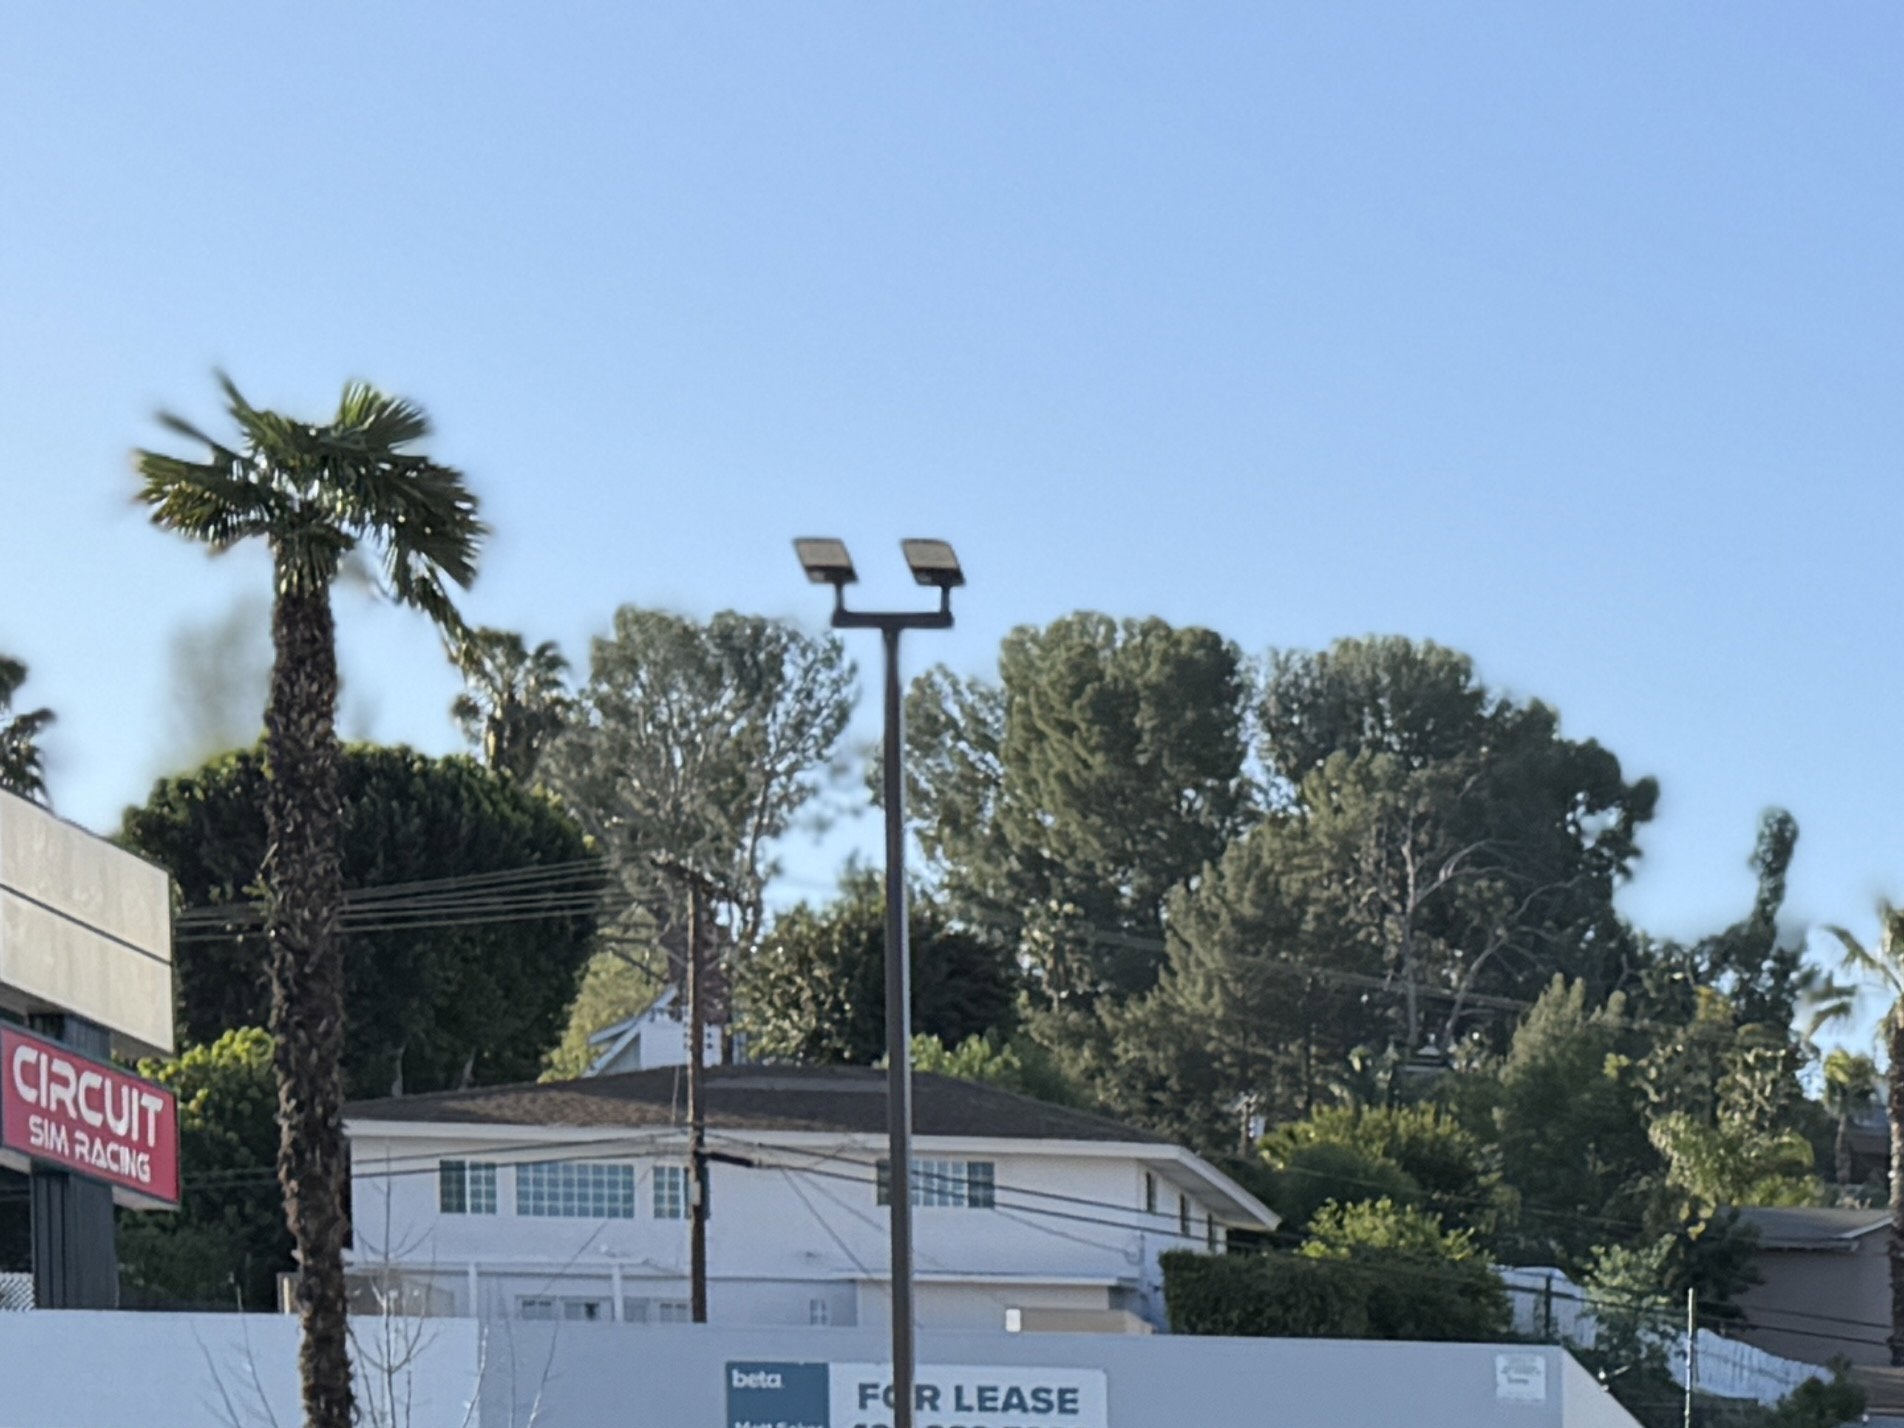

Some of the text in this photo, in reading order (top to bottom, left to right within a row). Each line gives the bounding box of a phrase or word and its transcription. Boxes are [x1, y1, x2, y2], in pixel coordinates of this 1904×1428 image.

[13, 1045, 164, 1148] CIRCUIT
[29, 1114, 152, 1183] SIM RACING
[954, 1385, 1079, 1415] LEASE
